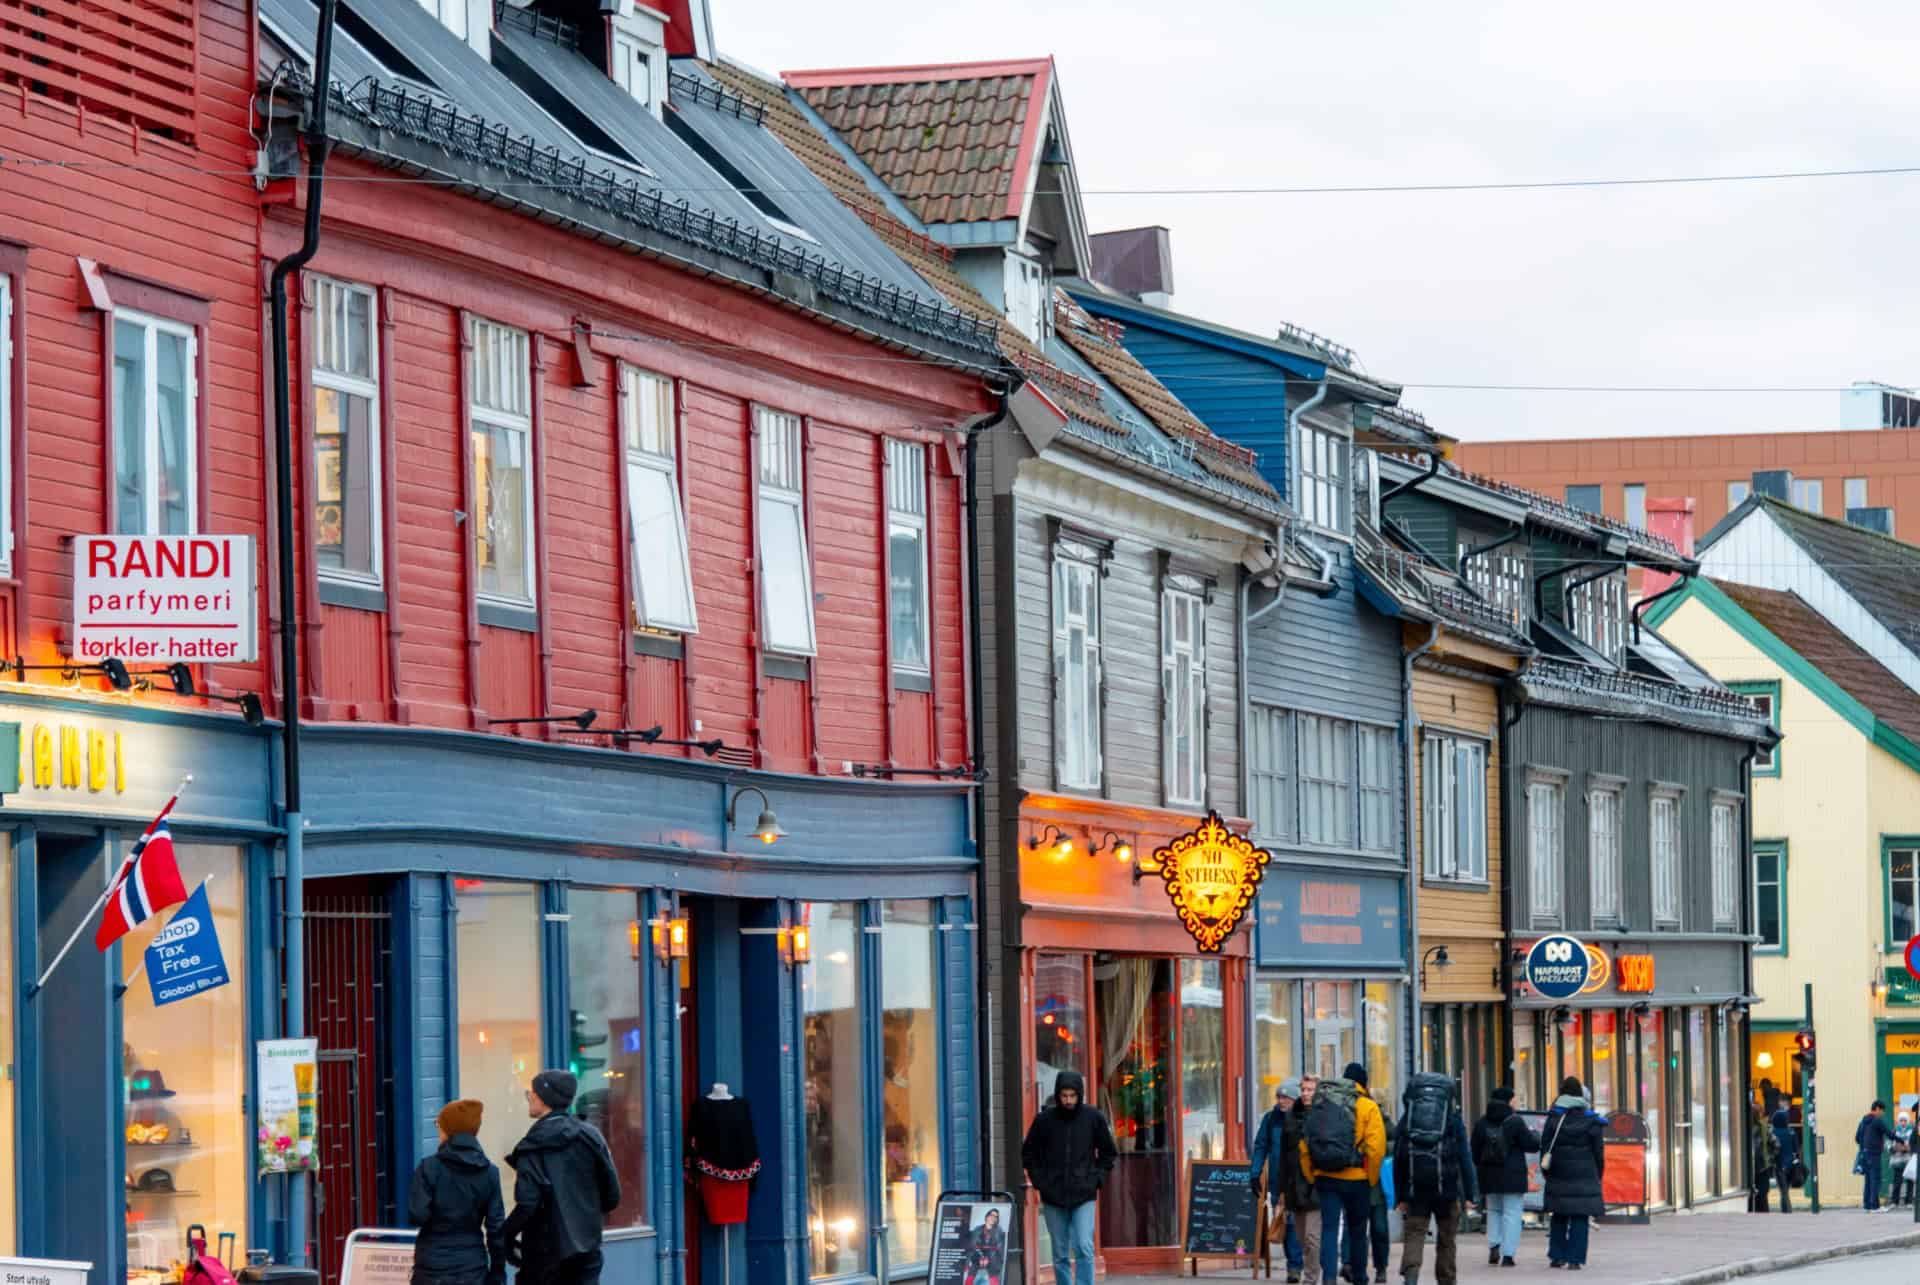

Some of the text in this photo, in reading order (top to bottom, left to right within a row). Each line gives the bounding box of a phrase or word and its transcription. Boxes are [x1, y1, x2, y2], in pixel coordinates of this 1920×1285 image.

[88, 540, 231, 578] RANDI
[88, 589, 231, 615] parfymeri
[19, 722, 126, 794] ANDI
[1201, 848, 1222, 864] NO
[1185, 867, 1238, 886] STRESS
[156, 943, 185, 960] Tax
[162, 955, 200, 974] Free
[160, 981, 196, 999] Global
